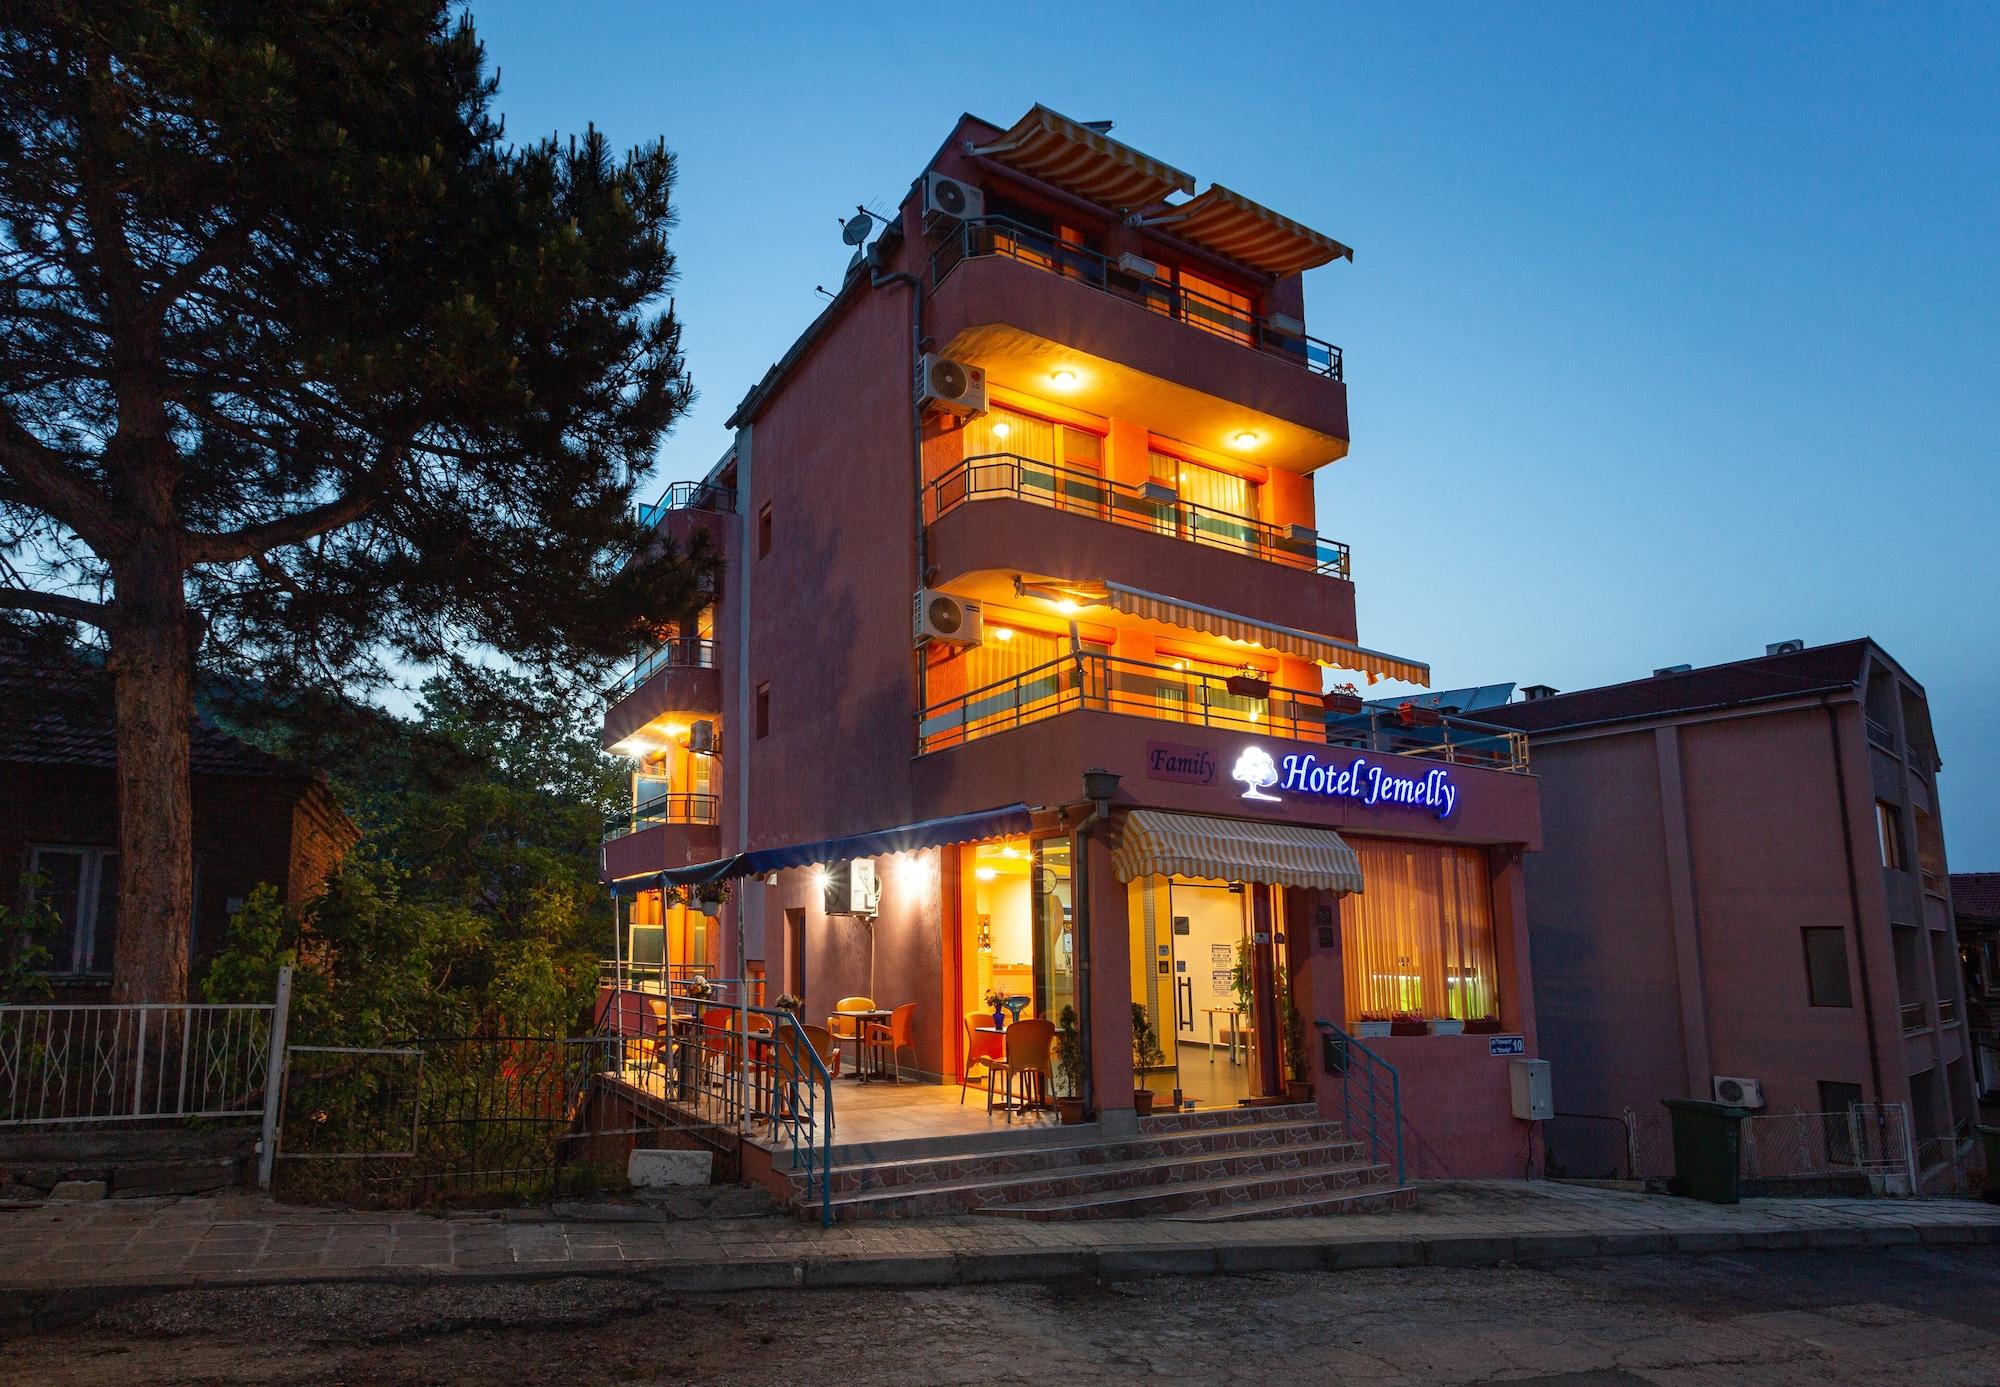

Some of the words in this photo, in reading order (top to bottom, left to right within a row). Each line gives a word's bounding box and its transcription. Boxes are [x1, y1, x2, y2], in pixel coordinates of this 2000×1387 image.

[1150, 748, 1215, 784] Family
[1280, 753, 1366, 797] Hotel
[1364, 766, 1456, 818] Jemelly
[1513, 1039, 1523, 1051] 10
